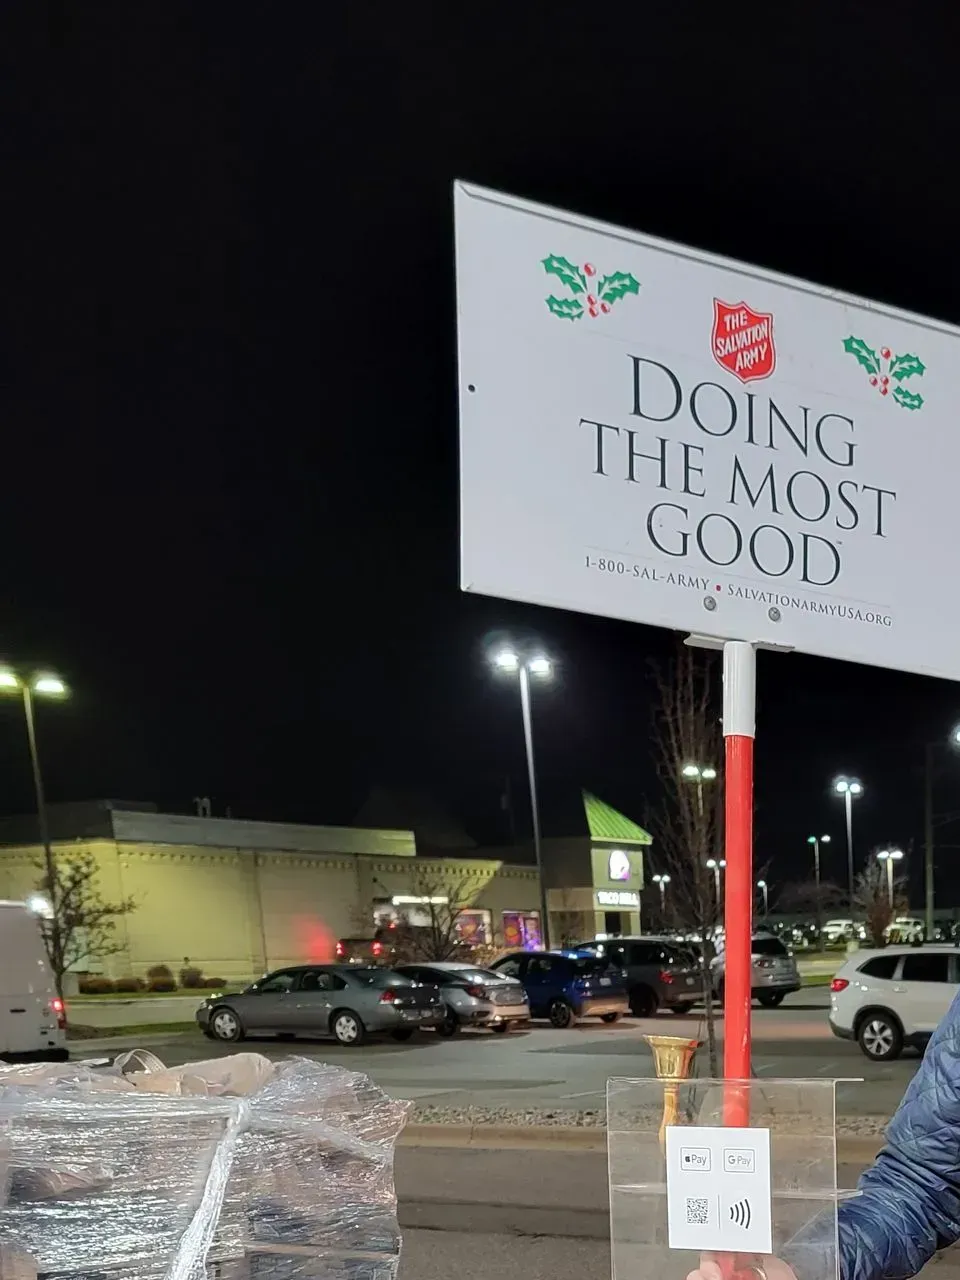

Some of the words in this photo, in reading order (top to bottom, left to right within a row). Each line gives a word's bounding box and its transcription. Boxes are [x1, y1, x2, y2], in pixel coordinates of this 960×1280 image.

[716, 319, 768, 358] SALVATION
[724, 310, 748, 332] THE
[735, 342, 768, 372] ARMY
[627, 354, 858, 467] DOING
[579, 418, 707, 498] THE
[729, 455, 897, 538] MOST
[646, 502, 842, 586] GOOD
[585, 555, 711, 592] 1-800-SAL-ARMY
[598, 891, 618, 904] TACO
[619, 892, 639, 905] BELL
[691, 1154, 707, 1166] Pay
